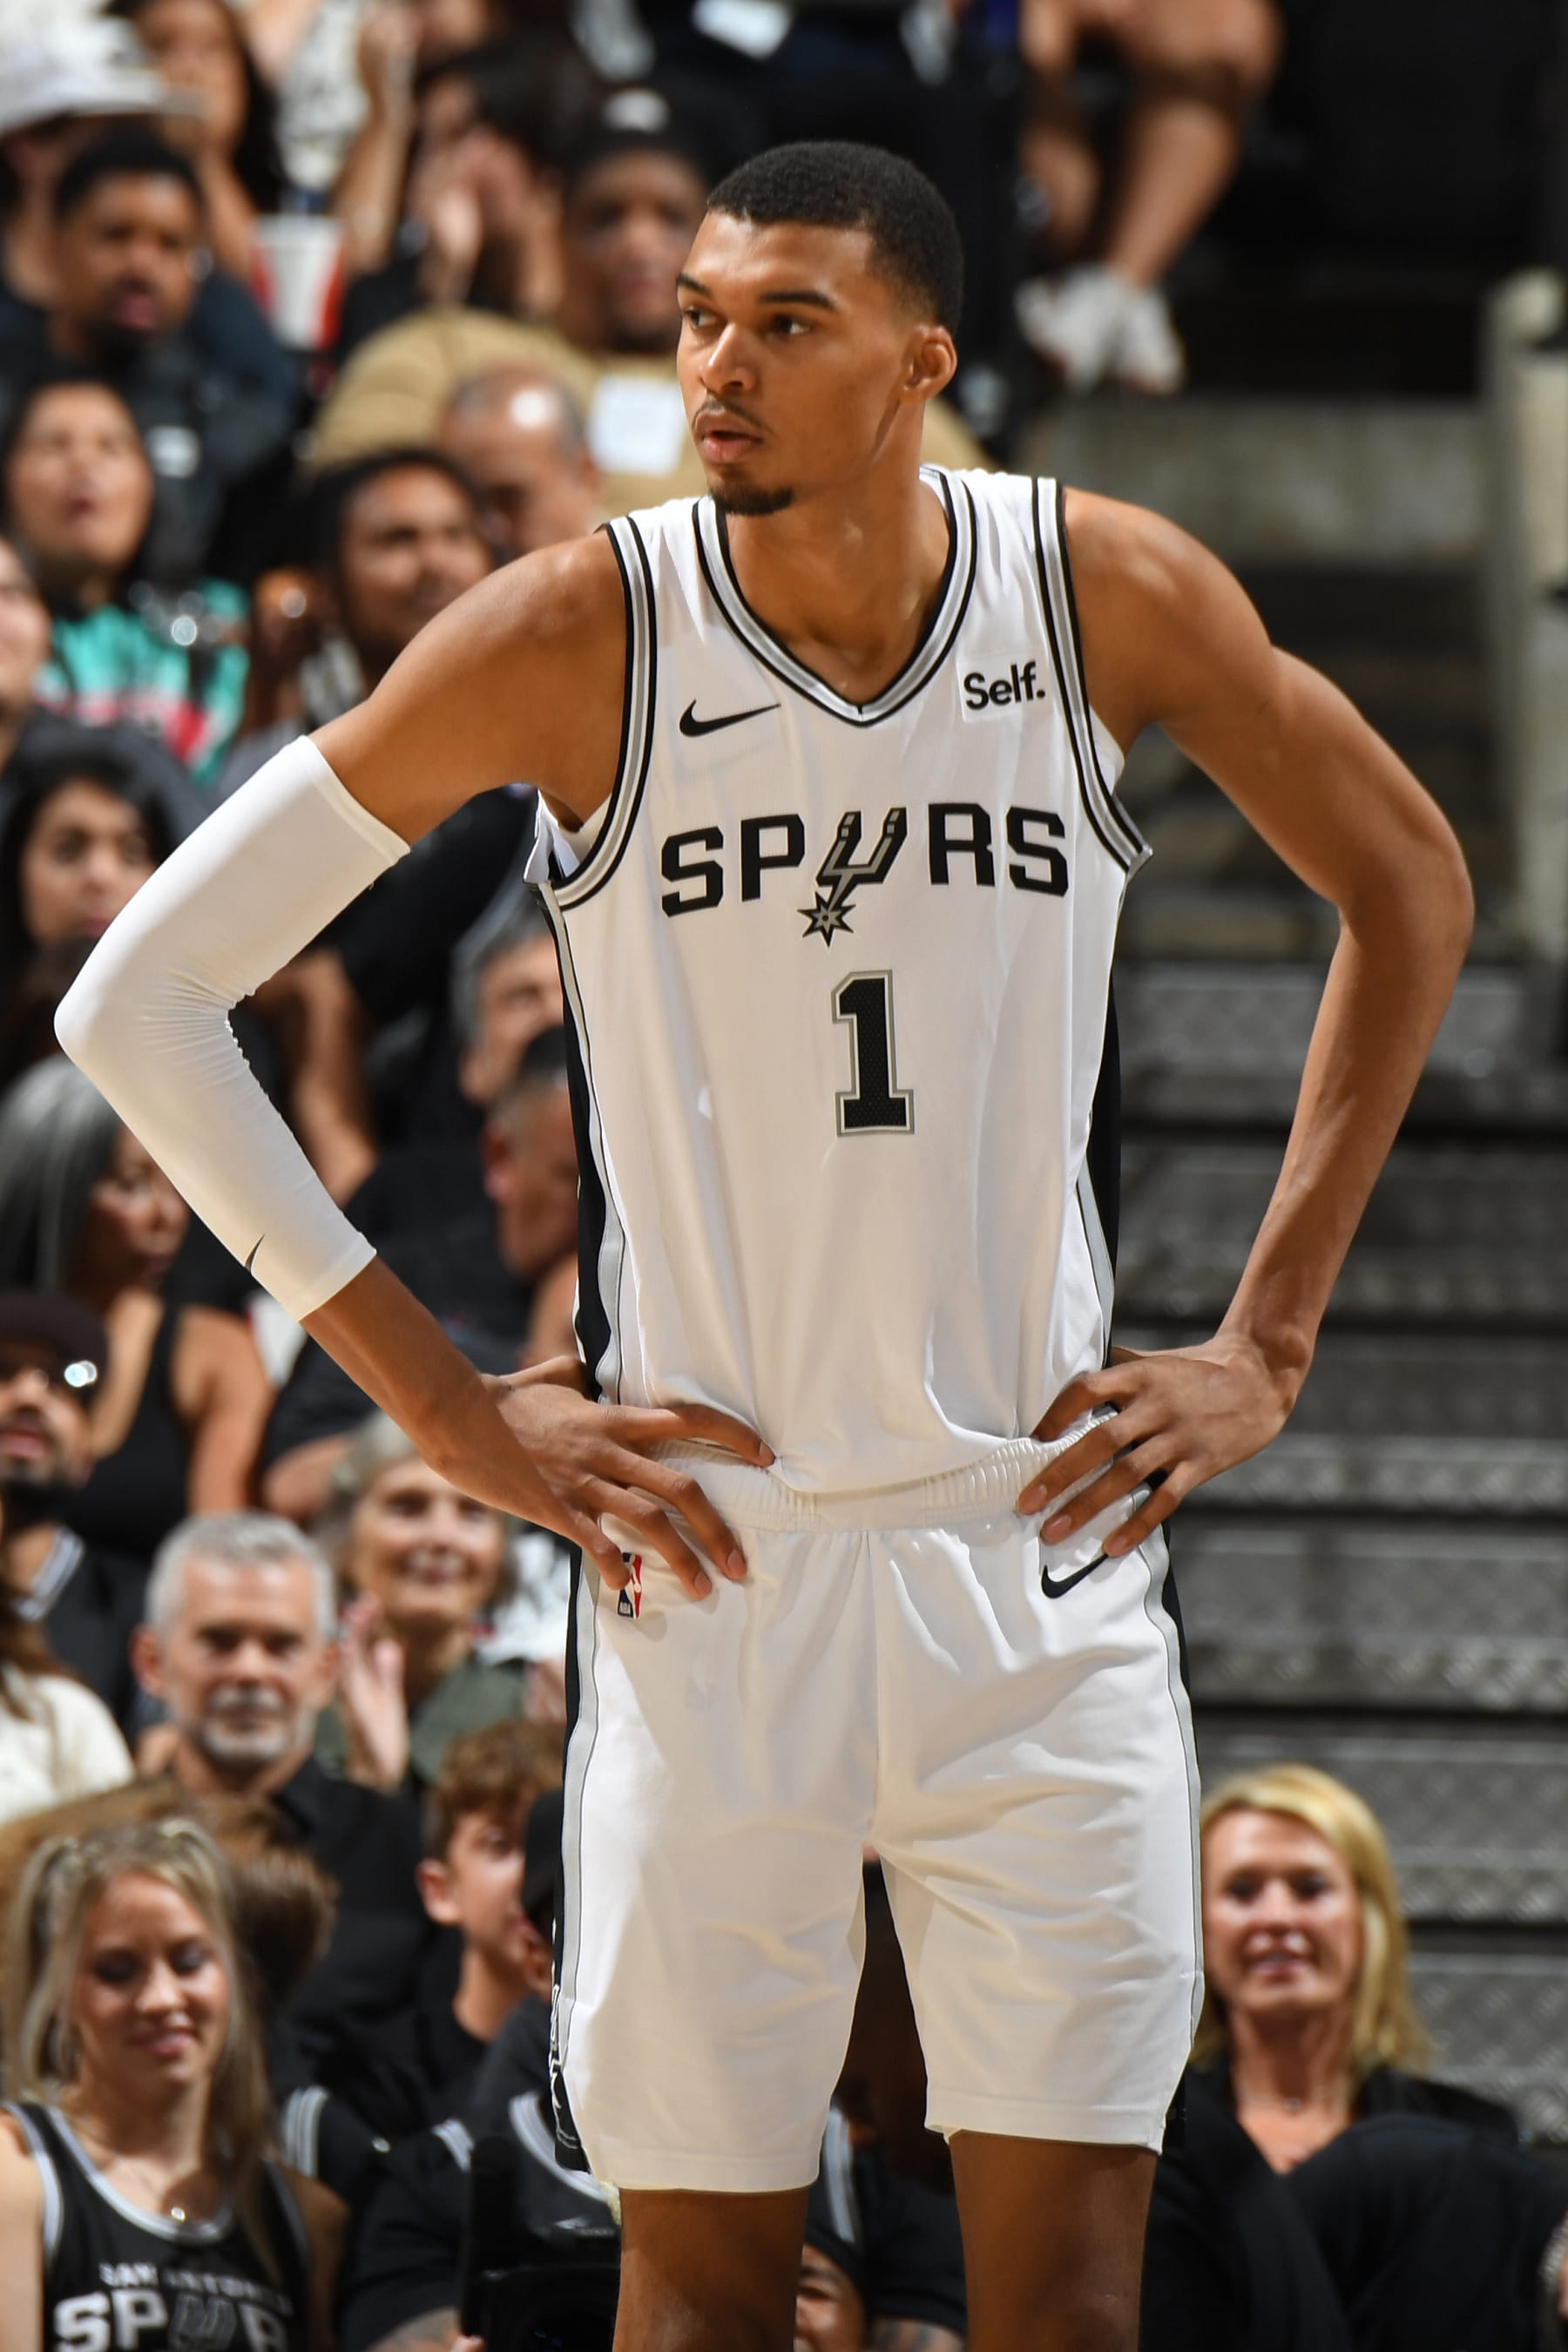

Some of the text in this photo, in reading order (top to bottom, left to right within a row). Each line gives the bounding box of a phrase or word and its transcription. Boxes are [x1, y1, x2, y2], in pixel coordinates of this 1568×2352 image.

[963, 659, 1047, 712] Self.
[660, 802, 1069, 949] SPURS
[830, 969, 916, 1138] 1
